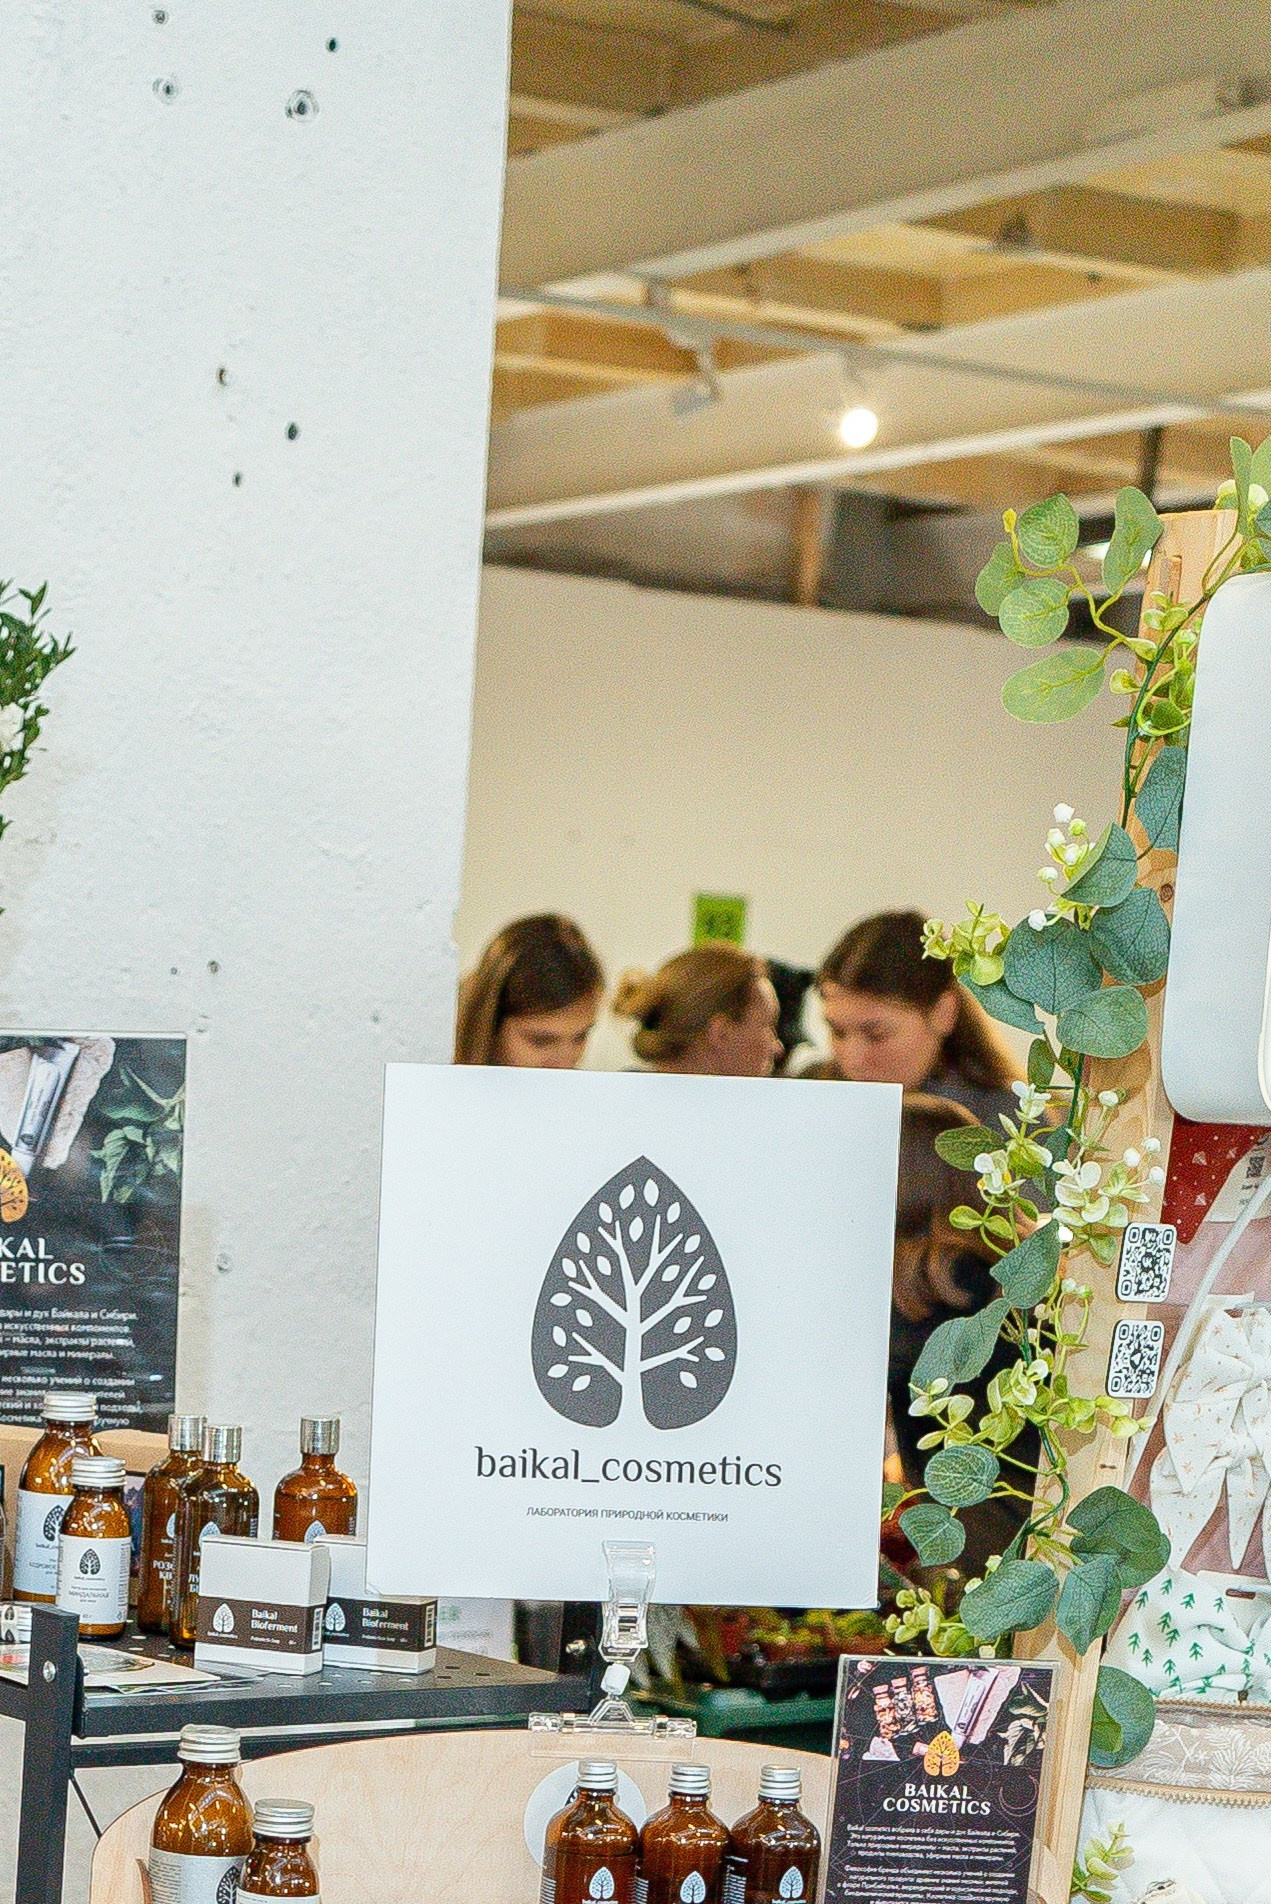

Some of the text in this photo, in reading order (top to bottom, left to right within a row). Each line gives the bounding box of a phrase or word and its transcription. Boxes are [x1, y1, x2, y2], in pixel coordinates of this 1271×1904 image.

[474, 1445, 783, 1487] baikal_cosmetics
[525, 1505, 729, 1523] ЛАБОРАТОРИЯ ПРИРОДНОЙ КОСМЕТИКИ
[251, 1608, 278, 1620] Baikal
[250, 1619, 298, 1633] Bioferment
[905, 1783, 972, 1800] BAIKAL
[883, 1798, 991, 1815] COSMETICS
